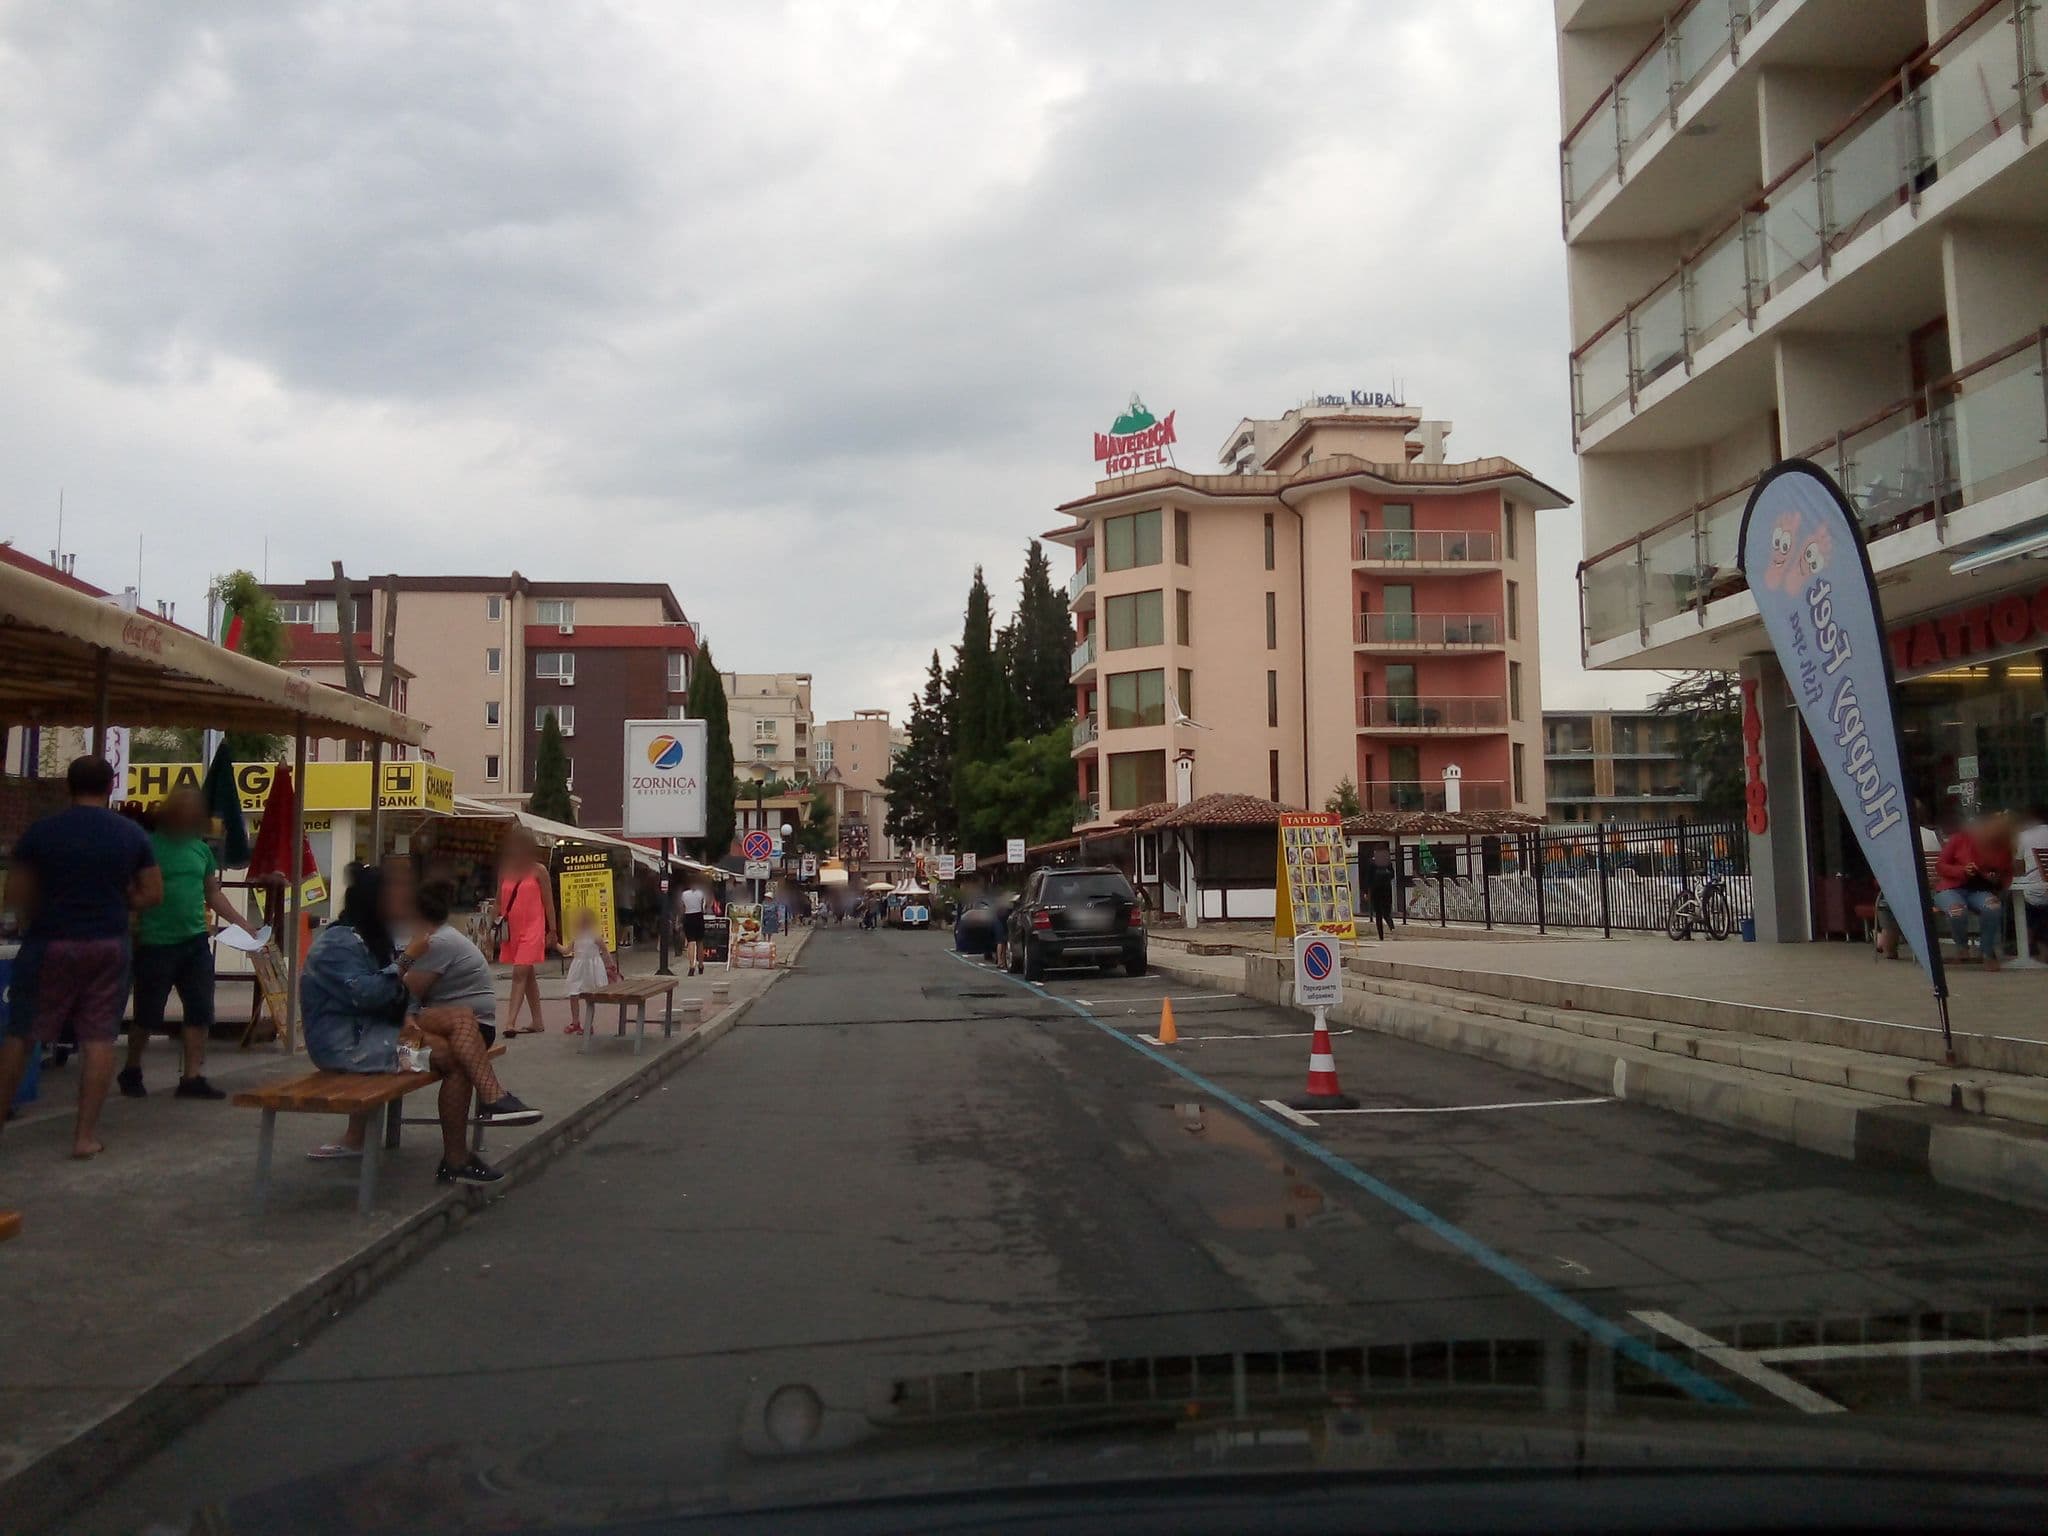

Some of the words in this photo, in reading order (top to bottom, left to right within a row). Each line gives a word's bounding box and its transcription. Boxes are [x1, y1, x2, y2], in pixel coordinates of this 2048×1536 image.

[1351, 390, 1395, 407] KUBA
[1094, 409, 1176, 461] MAVERICK
[1106, 448, 1167, 474] HOTEL
[632, 777, 697, 789] ZORNICA
[379, 796, 417, 807] BANK
[1286, 816, 1328, 825] TATTOO
[563, 853, 608, 864] CHANGE
